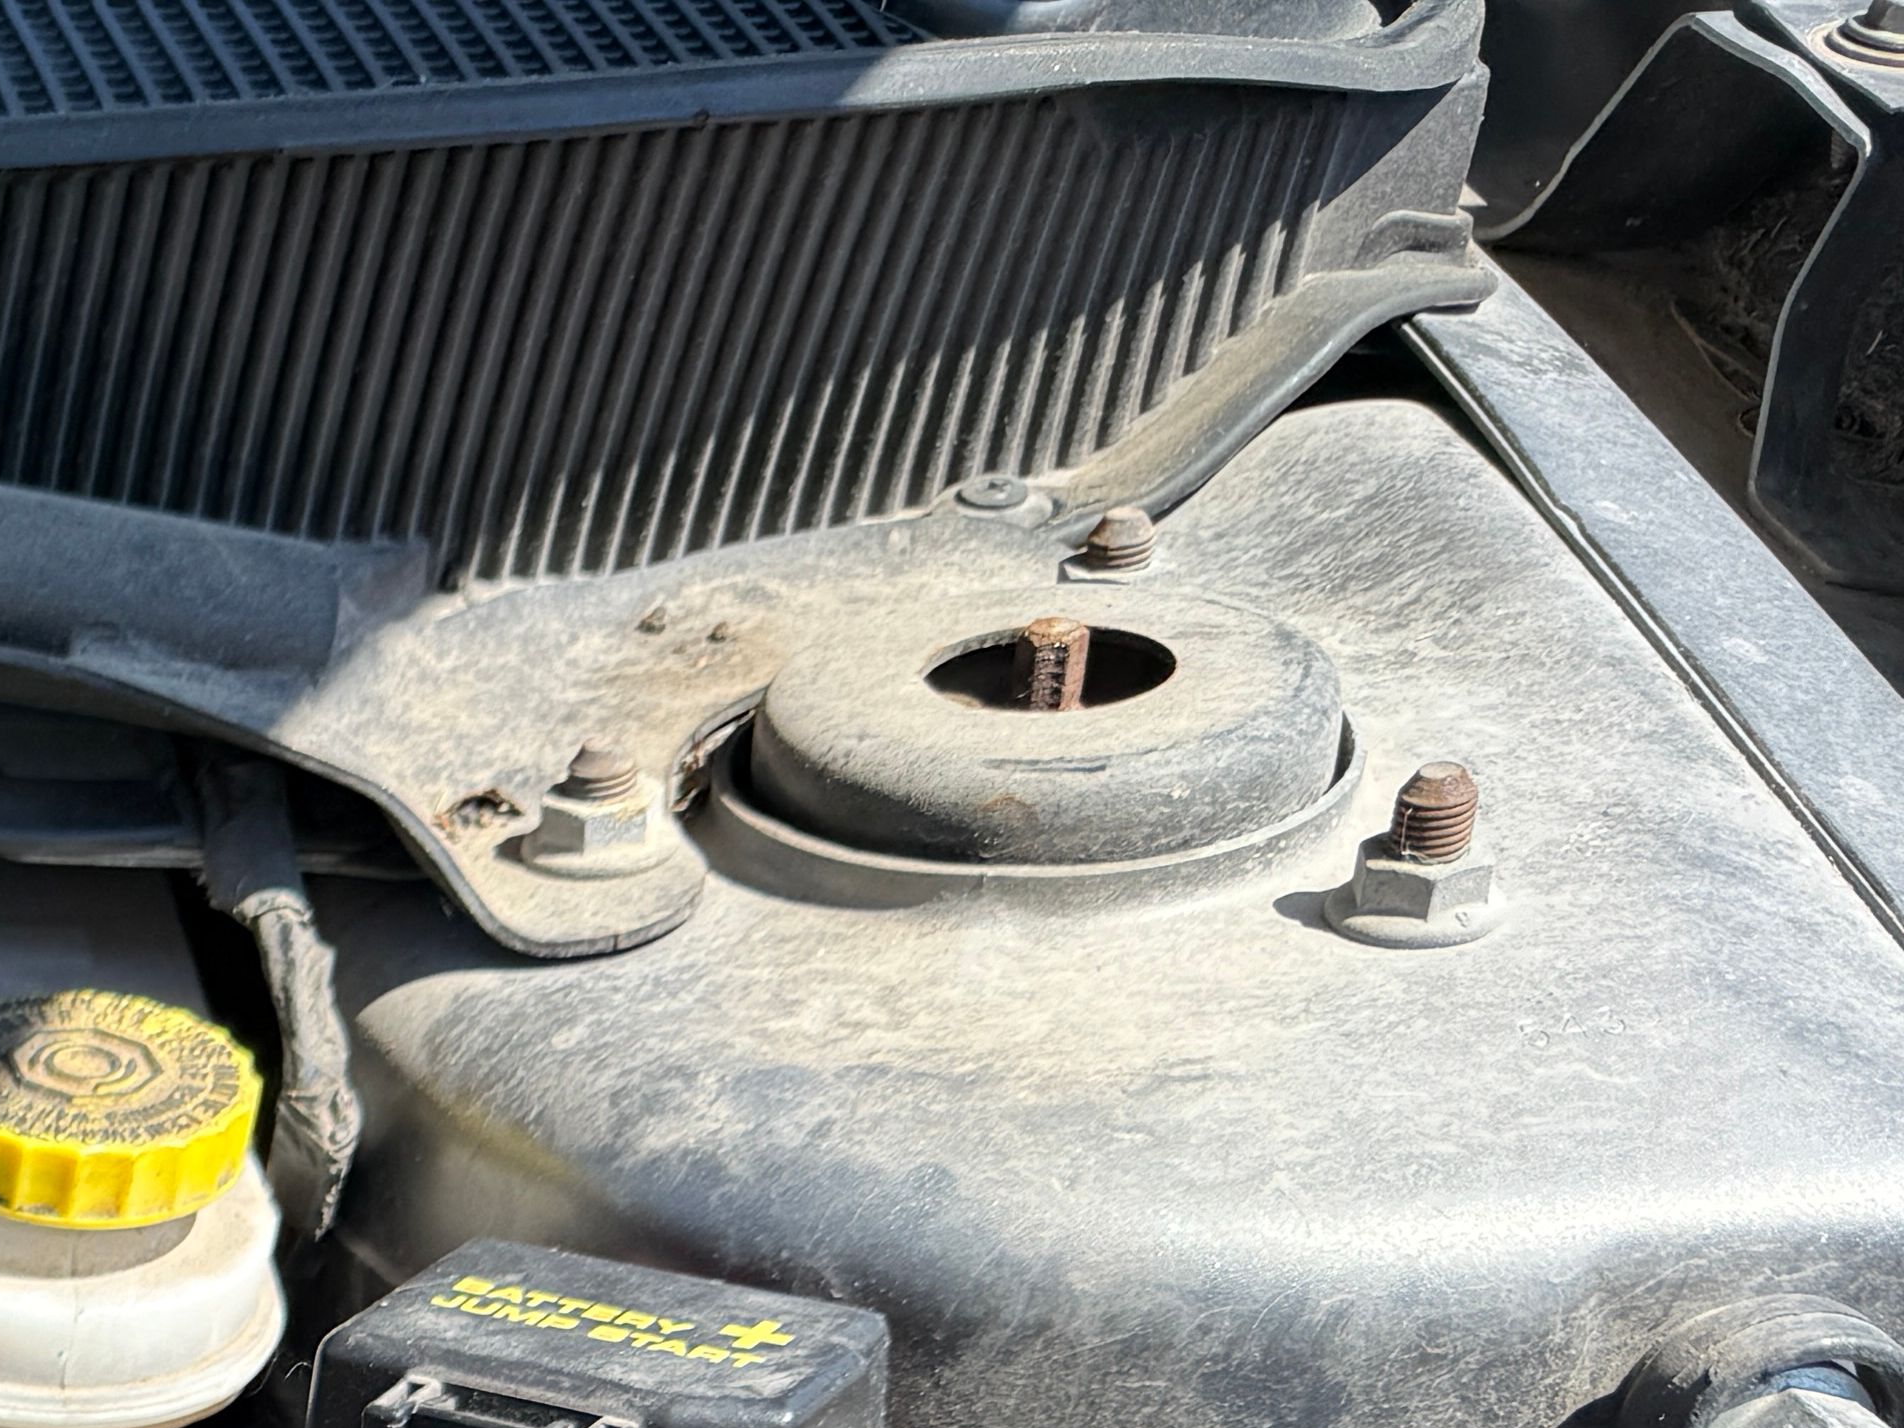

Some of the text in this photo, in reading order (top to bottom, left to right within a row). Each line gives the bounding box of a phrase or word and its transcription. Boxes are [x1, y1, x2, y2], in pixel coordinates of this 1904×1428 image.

[430, 1295, 768, 1368] JUMP START
[452, 1276, 695, 1335] BATTERY
